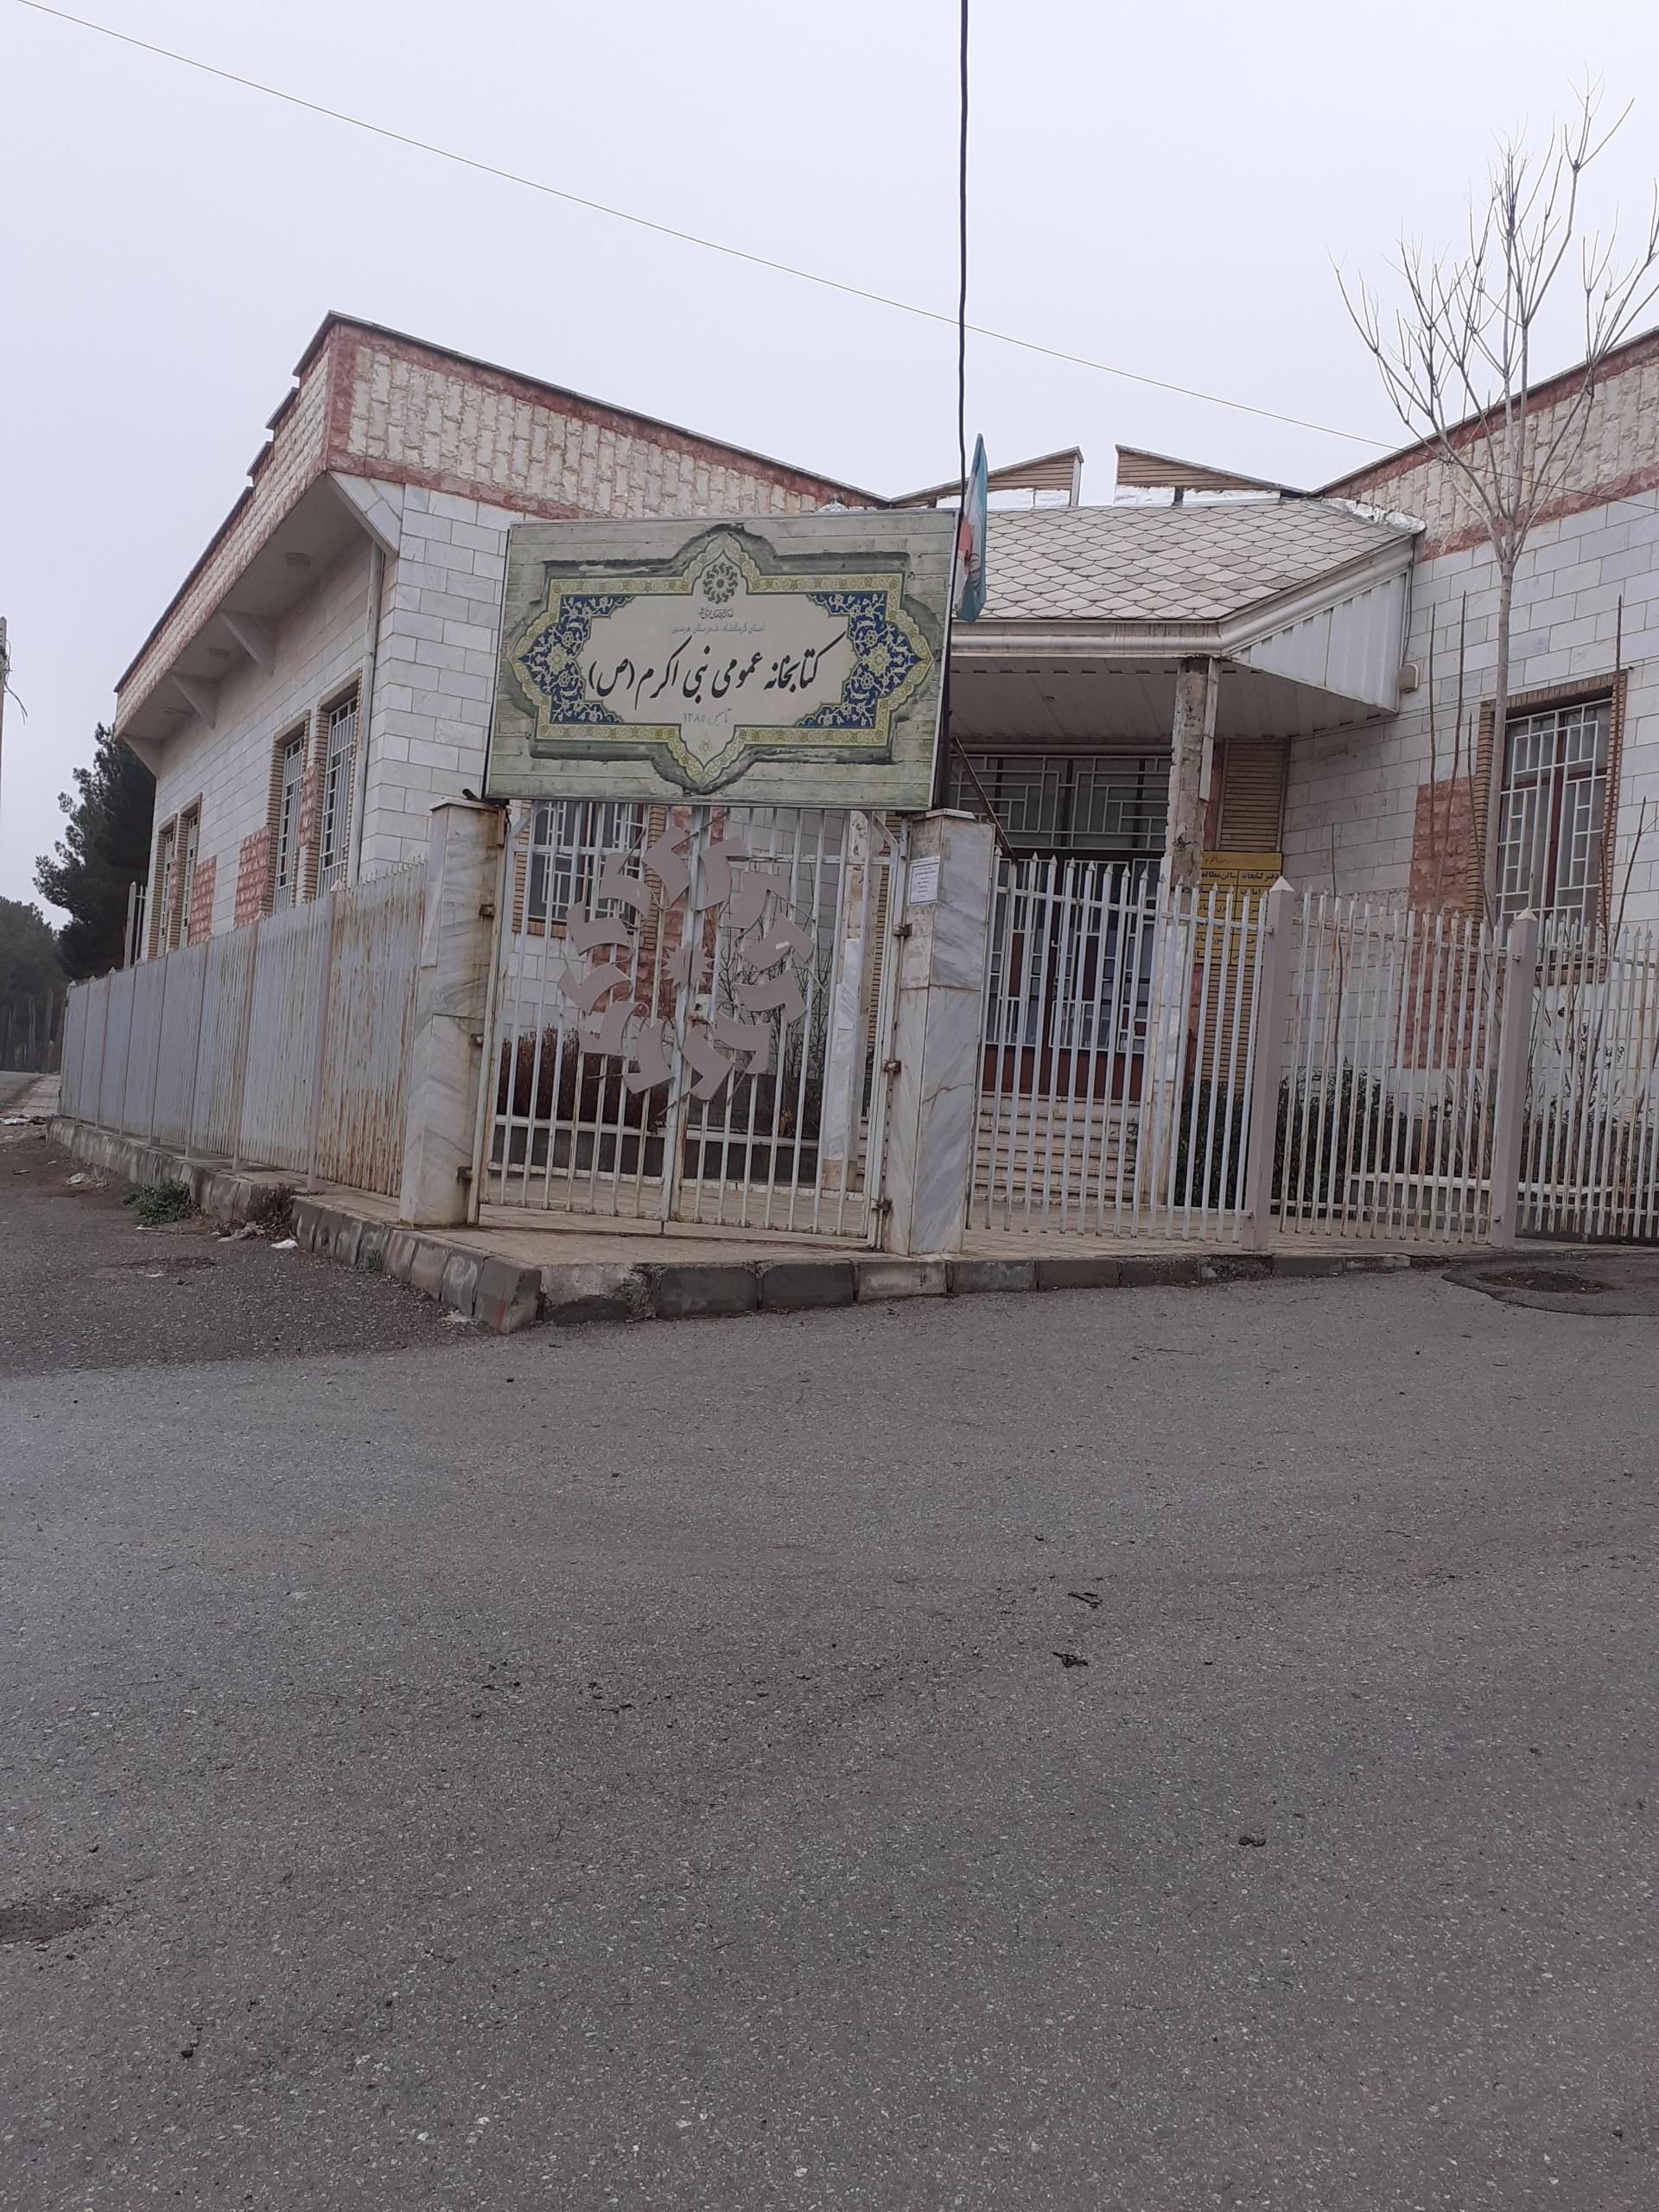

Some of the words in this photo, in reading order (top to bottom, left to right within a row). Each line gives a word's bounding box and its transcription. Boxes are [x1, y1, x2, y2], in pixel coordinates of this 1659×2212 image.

[588, 658, 635, 698] (ص)
[634, 634, 693, 711] اکرم
[682, 645, 711, 704] نبی
[710, 652, 763, 699] عمومی
[764, 631, 847, 694] کتابخانه
